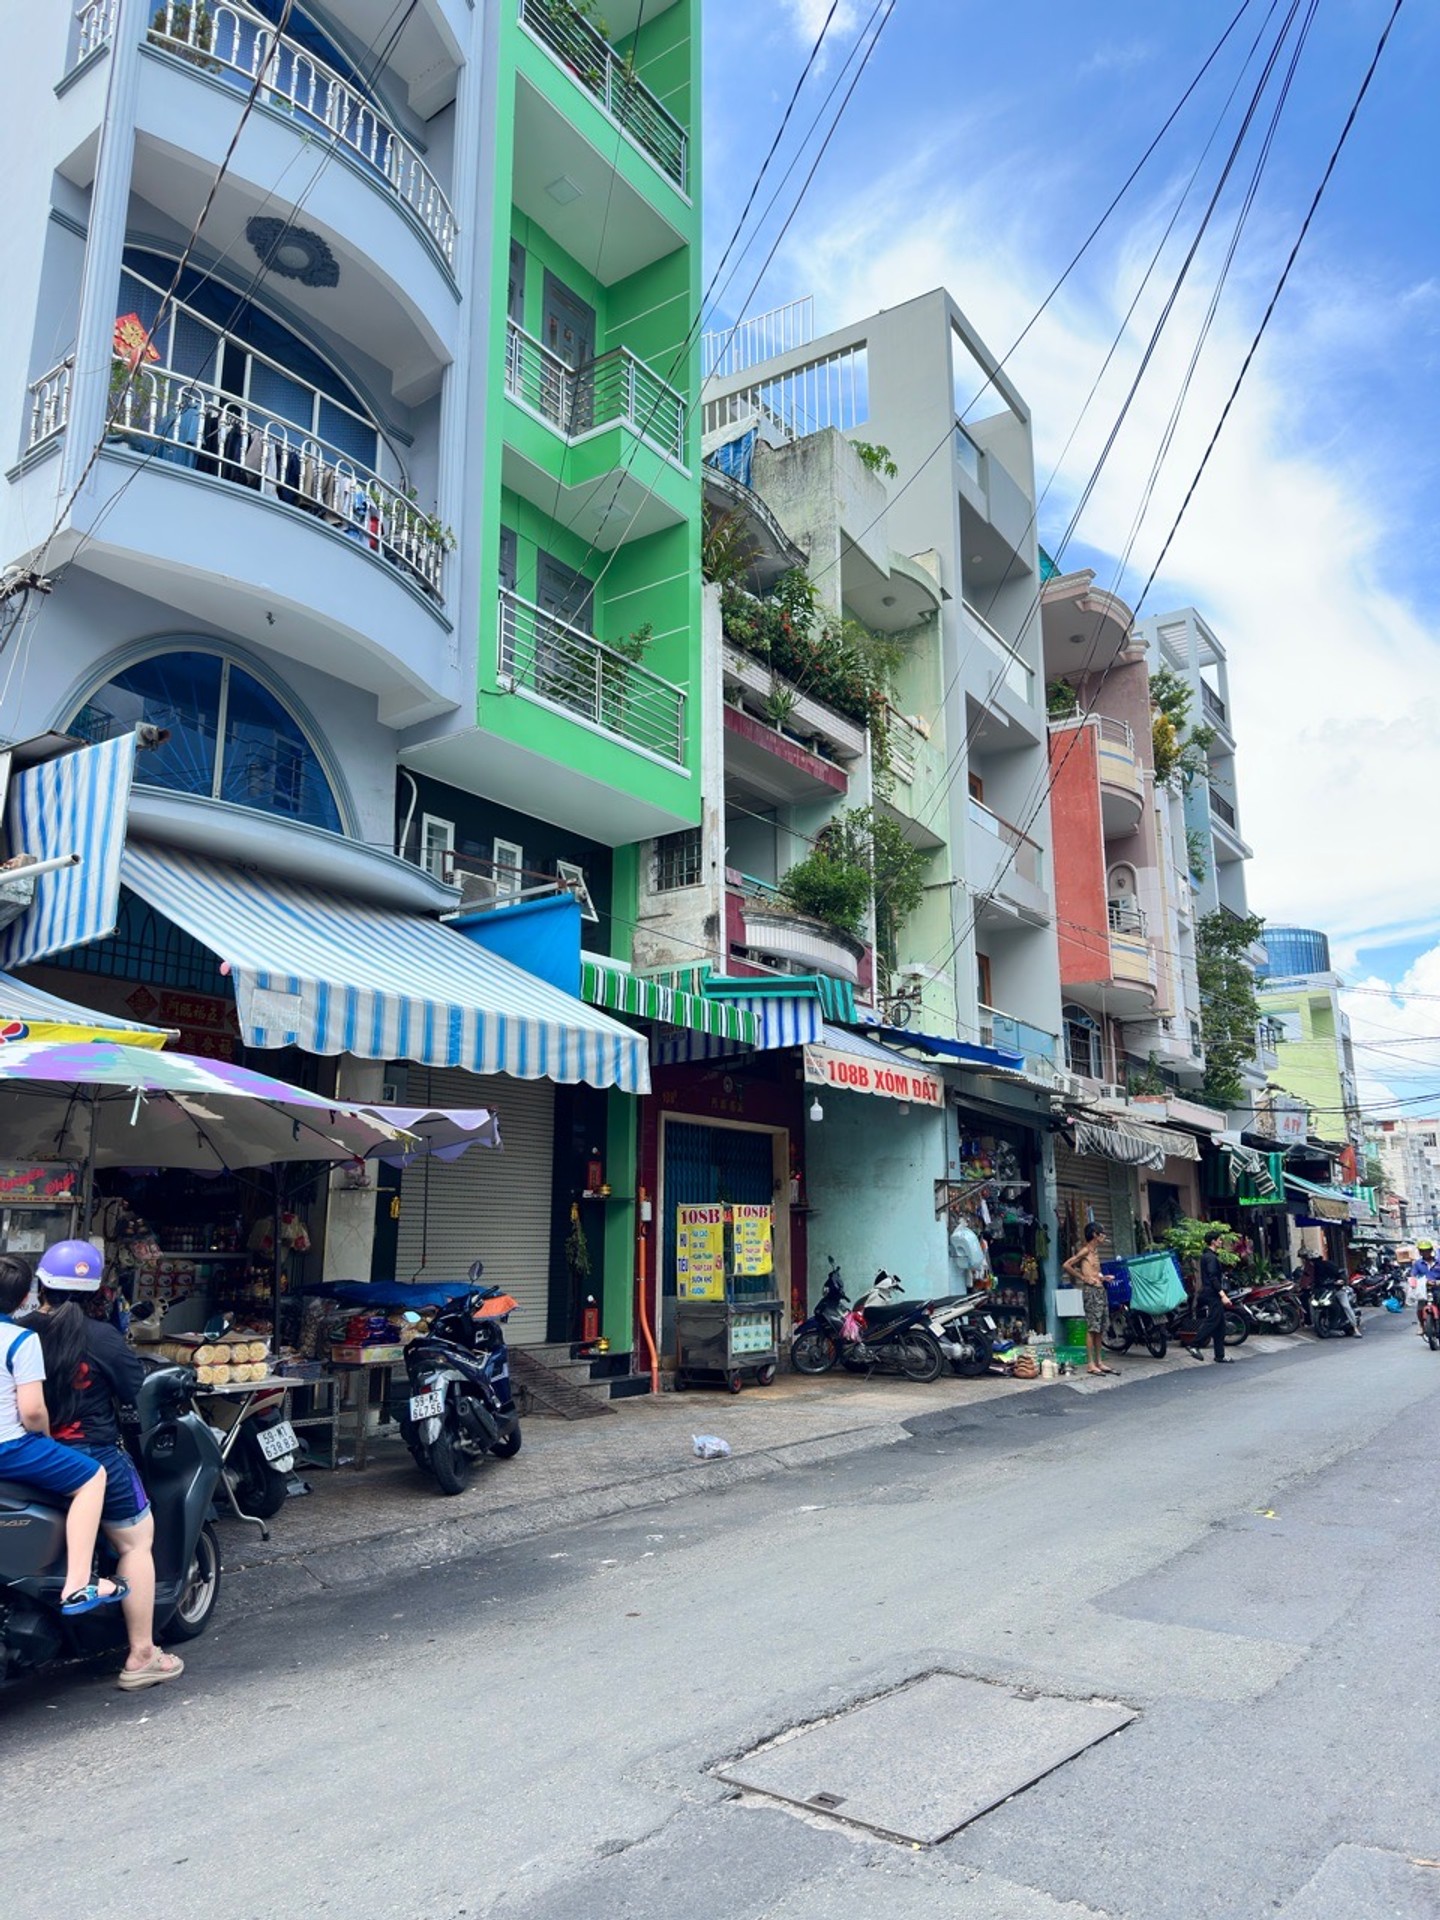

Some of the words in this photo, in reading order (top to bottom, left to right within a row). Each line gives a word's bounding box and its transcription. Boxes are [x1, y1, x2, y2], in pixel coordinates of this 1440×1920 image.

[828, 1060, 869, 1087] 108B
[874, 1069, 908, 1095] XÓM
[912, 1075, 938, 1101] ĐẤT
[681, 1209, 720, 1224] 108B
[737, 1206, 768, 1218] 108B
